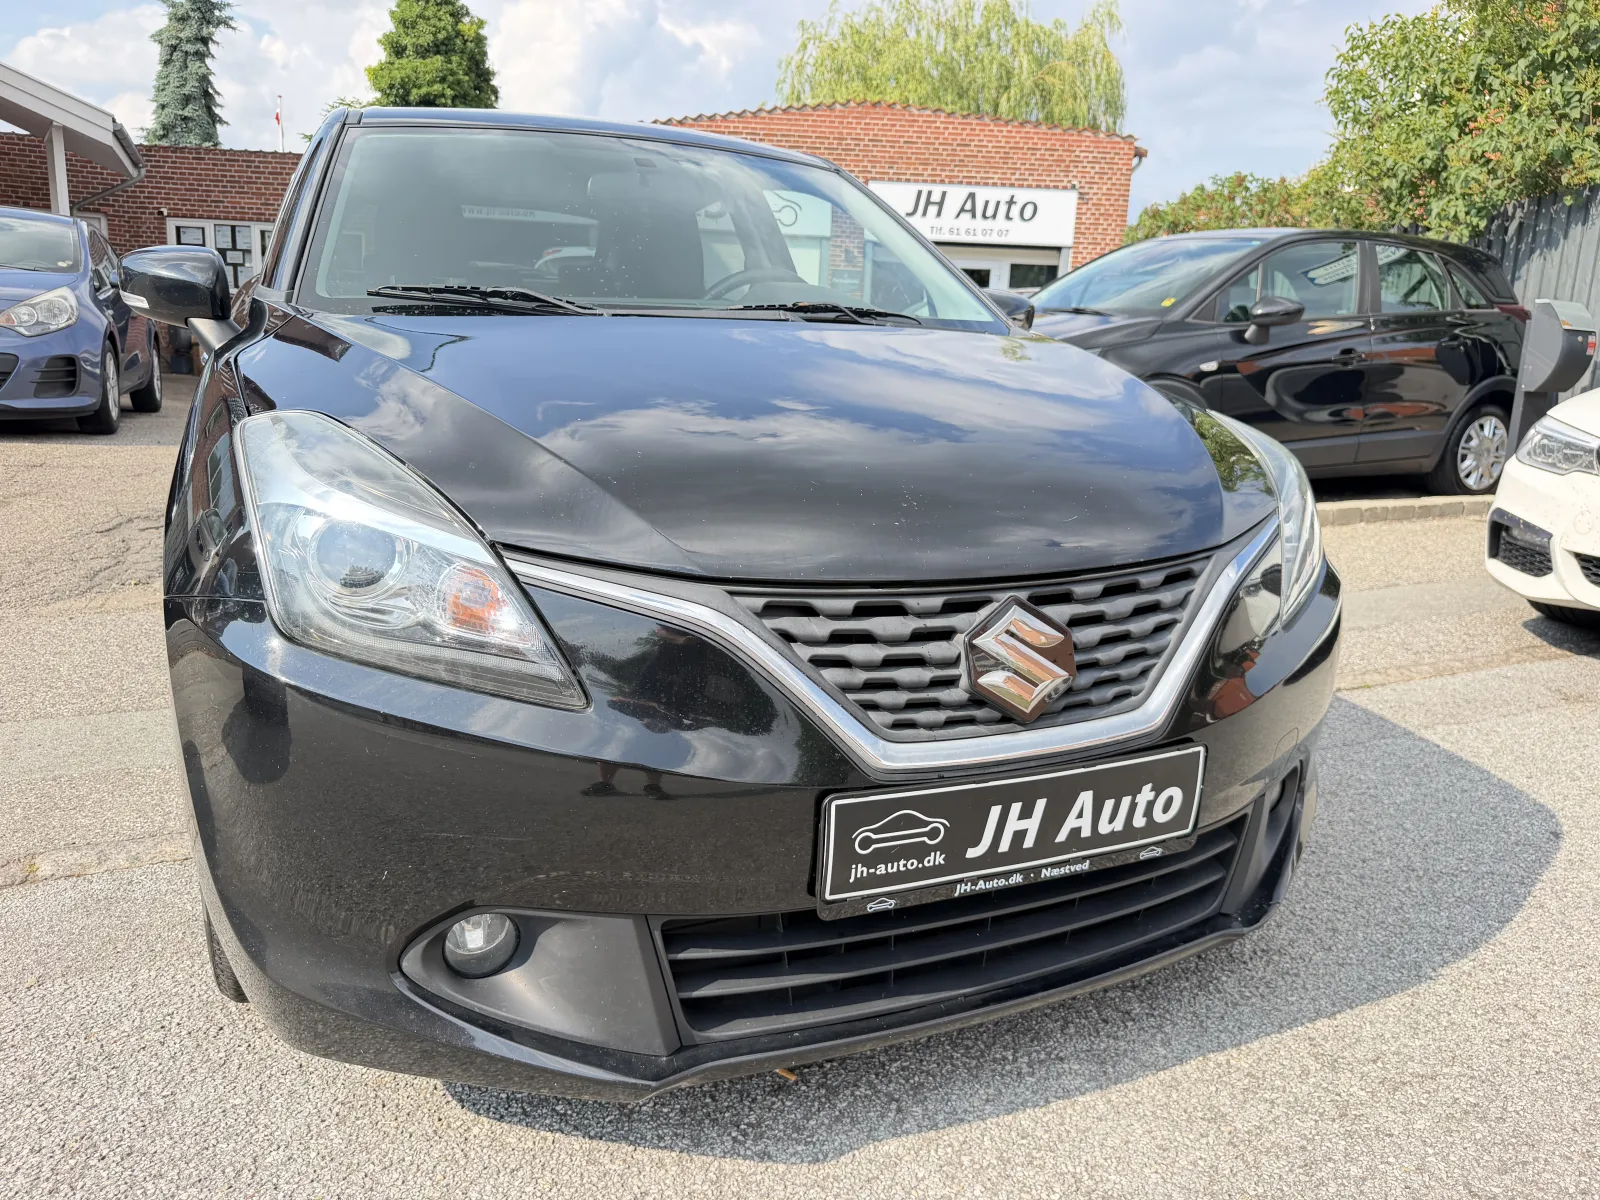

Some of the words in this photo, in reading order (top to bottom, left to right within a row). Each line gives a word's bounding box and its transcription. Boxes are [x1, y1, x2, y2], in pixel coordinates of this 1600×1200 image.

[905, 189, 947, 218] JH
[955, 191, 1038, 222] Auto
[948, 227, 961, 236] 61
[964, 227, 977, 237] 61
[981, 228, 994, 238] 07
[996, 229, 1009, 238] 07
[965, 797, 1048, 860] JH
[1054, 782, 1184, 844] Auto
[849, 850, 946, 884] jh-auto.dk
[954, 873, 1024, 898] JH-Auto.dk
[1041, 859, 1090, 879] Næstved
